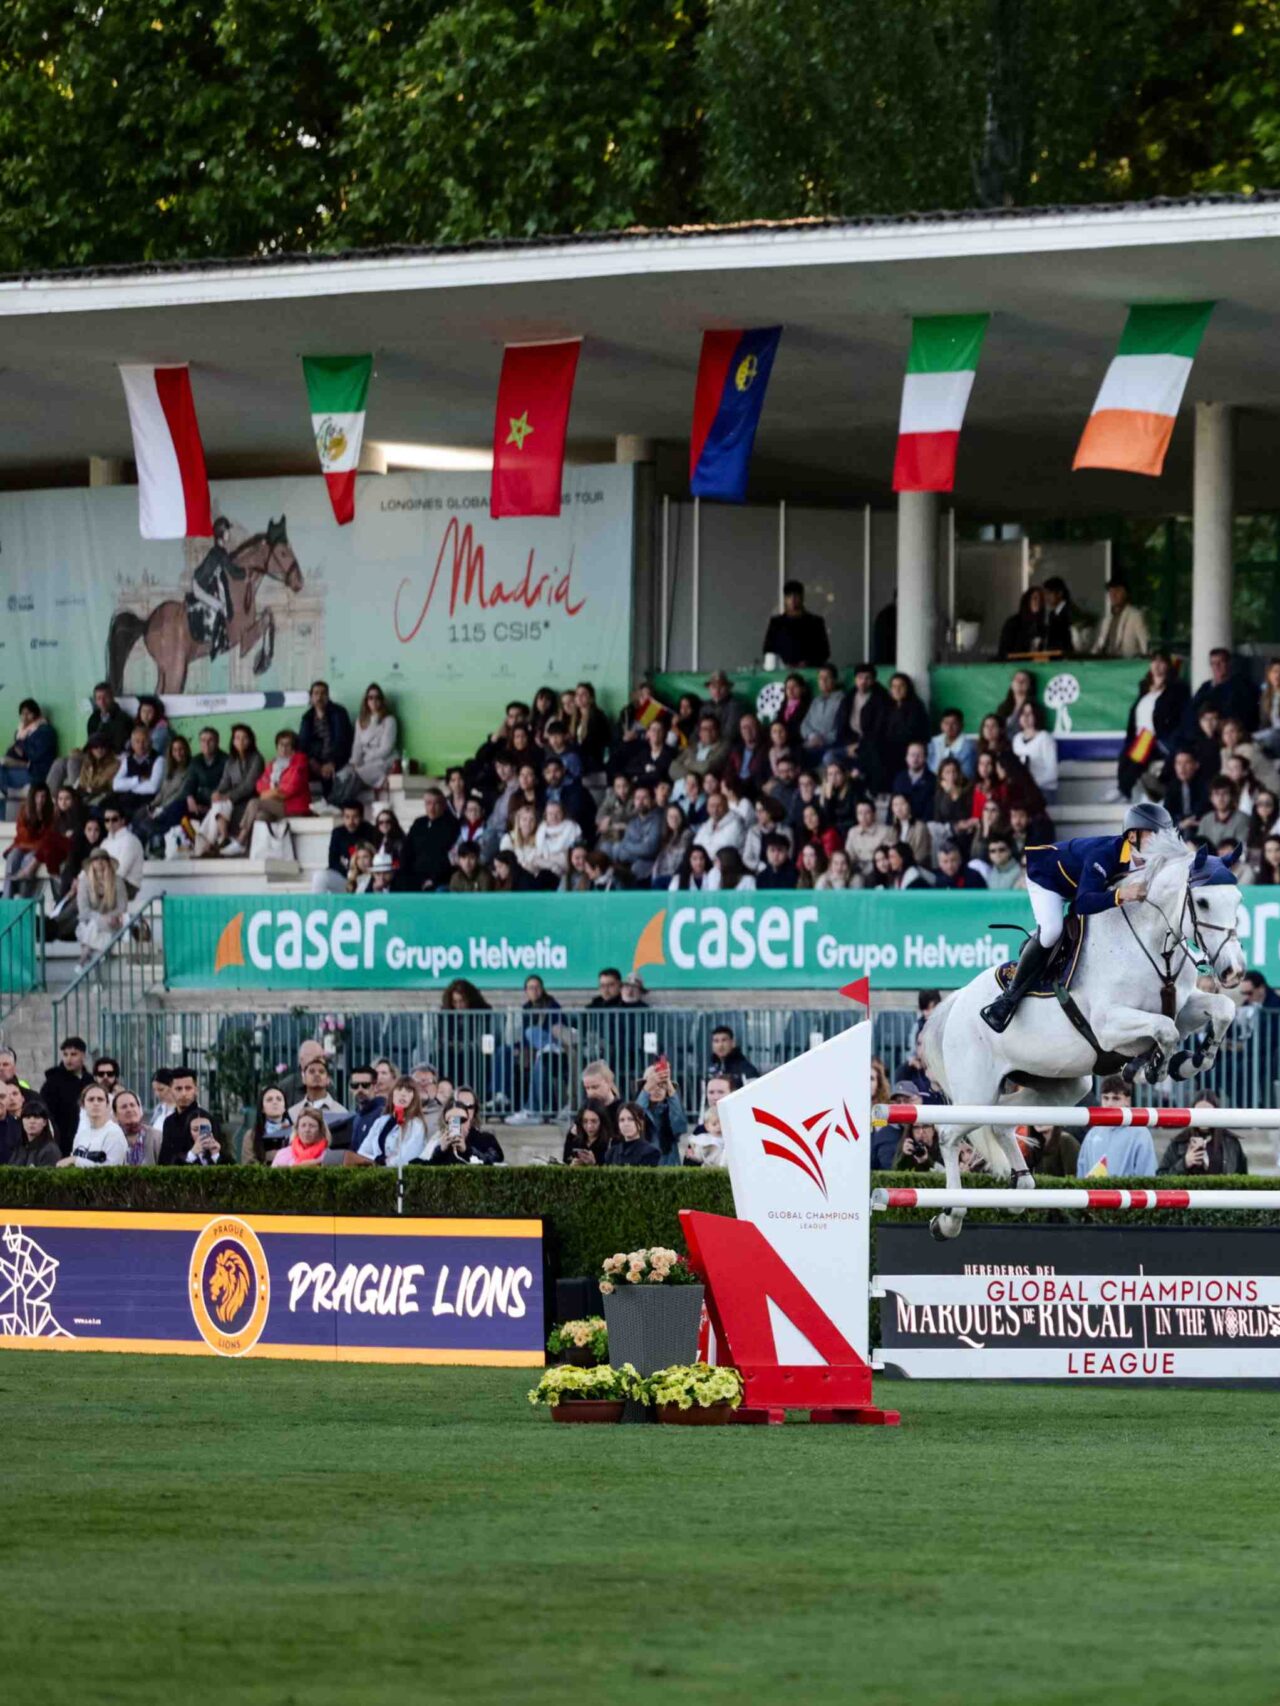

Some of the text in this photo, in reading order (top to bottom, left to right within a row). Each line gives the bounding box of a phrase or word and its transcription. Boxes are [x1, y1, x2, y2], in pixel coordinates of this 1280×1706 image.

[380, 497, 491, 511] LONGINES GLOBA
[575, 491, 604, 504] TOUR
[394, 516, 587, 643] Madrid
[448, 624, 486, 643] 115
[247, 909, 568, 977] caser Grupo Helvetia
[668, 905, 1010, 974] caser Grupo Helvetia
[767, 1210, 860, 1221] GLOBAL CHAMPIONS
[799, 1222, 827, 1230] LEAGUE
[213, 1223, 244, 1238] PRAGUE
[287, 1261, 533, 1319] PRAGUE LIONS
[987, 1280, 1258, 1302] GLOBAL CHAMPIONS
[1023, 1307, 1036, 1325] DE
[1039, 1304, 1133, 1339] RISCAL
[1155, 1307, 1172, 1335] IN
[1175, 1308, 1208, 1336] THE
[218, 1337, 241, 1350] LIONS
[1068, 1353, 1175, 1375] LEAGUE
